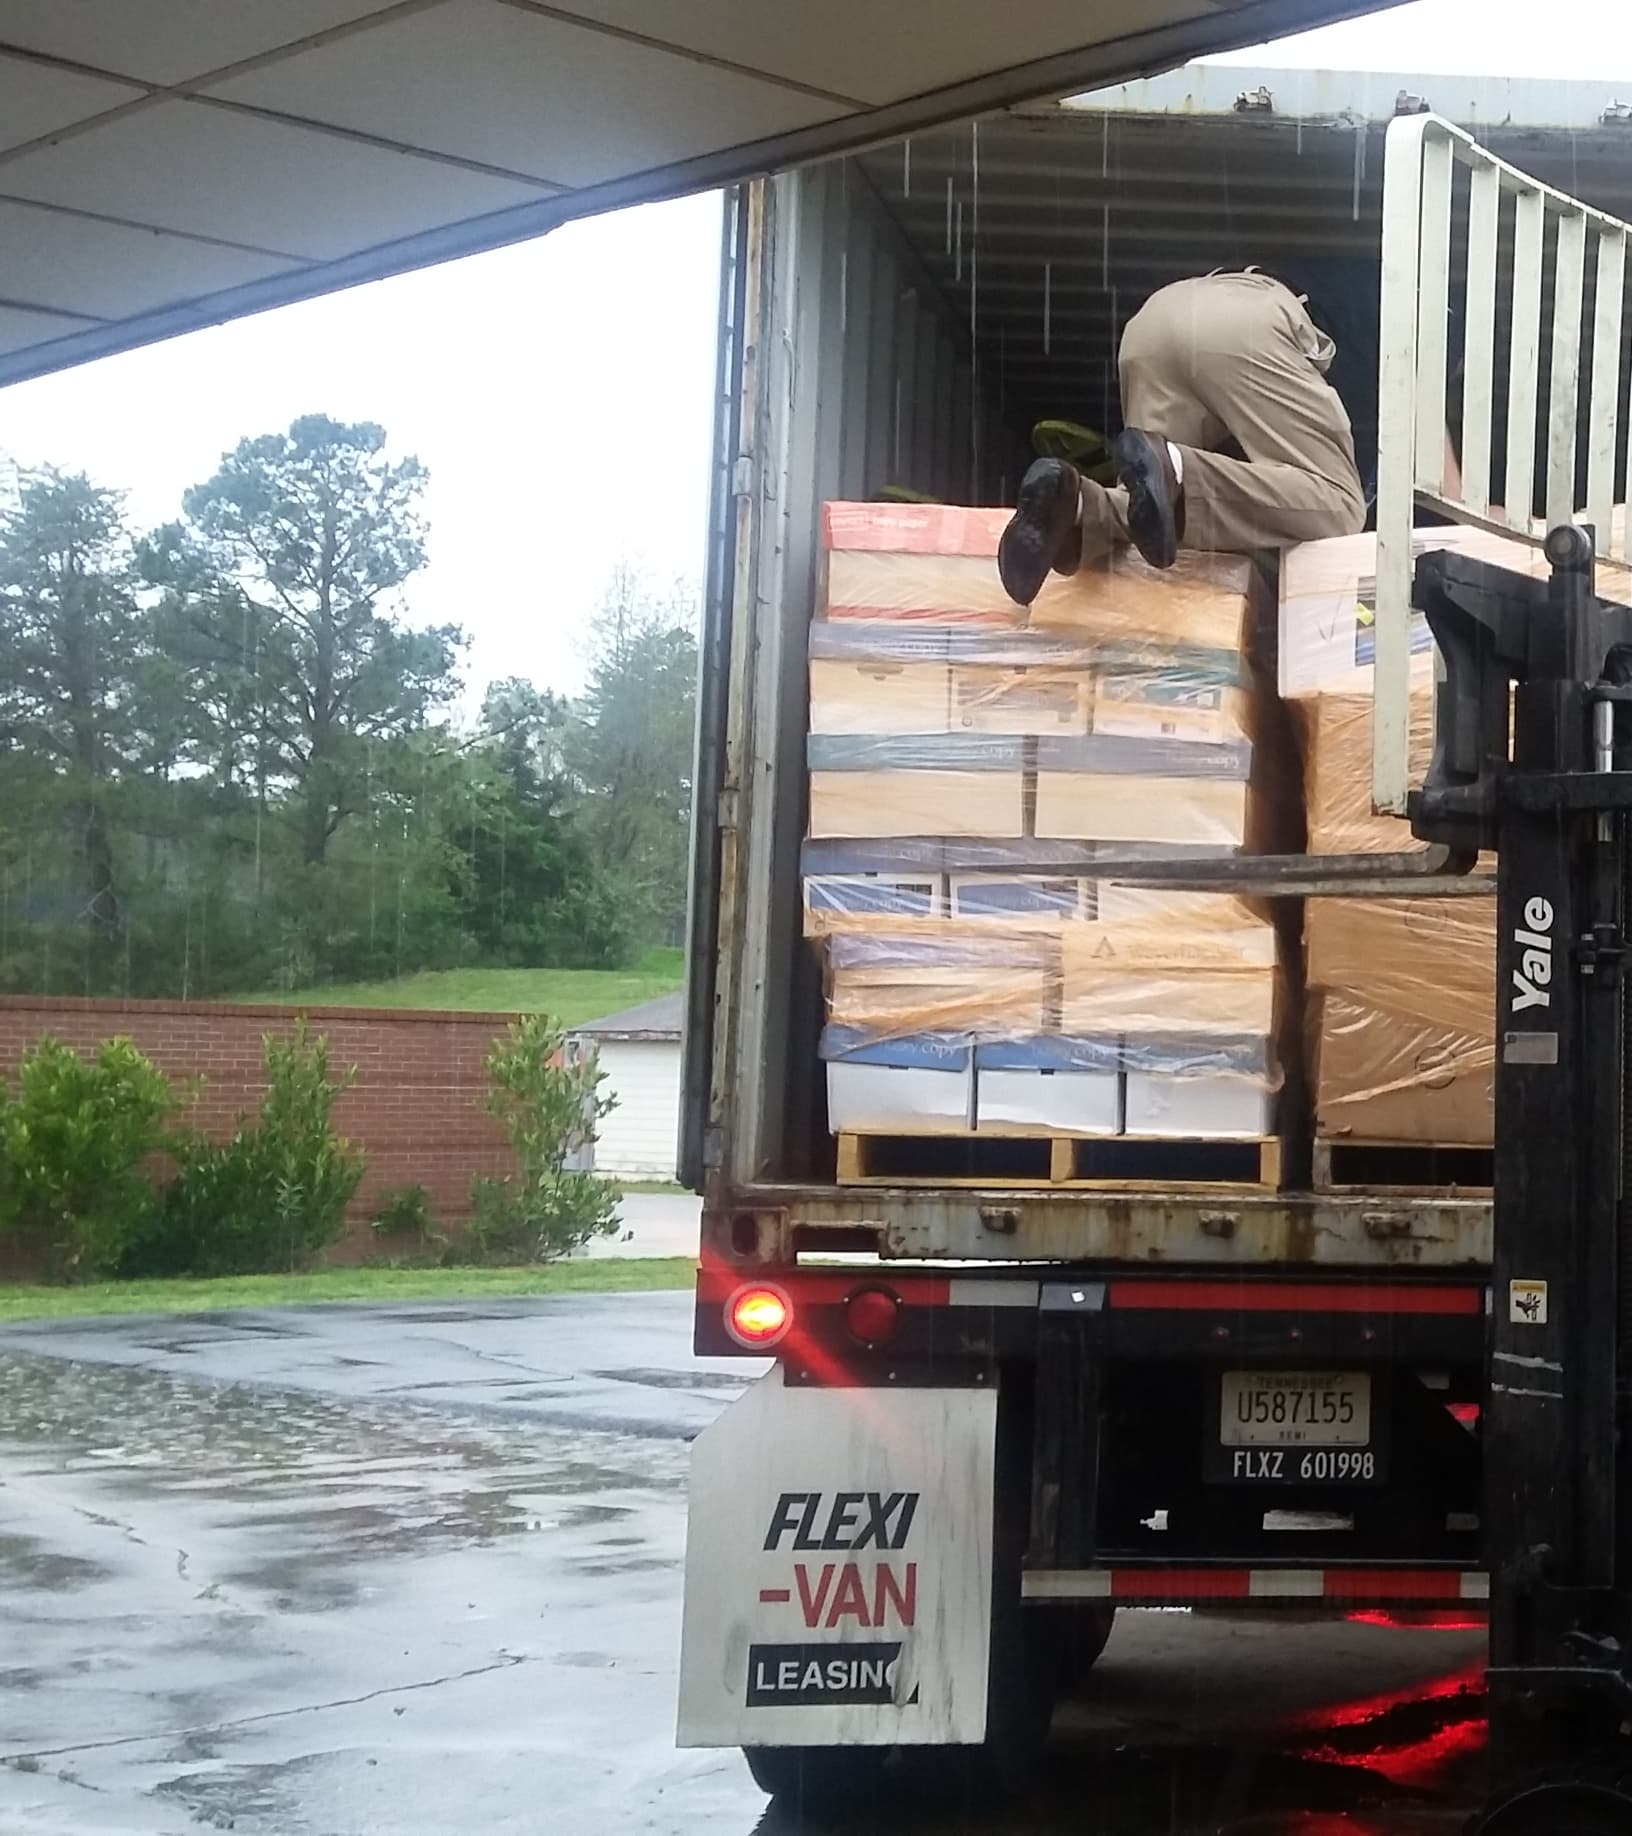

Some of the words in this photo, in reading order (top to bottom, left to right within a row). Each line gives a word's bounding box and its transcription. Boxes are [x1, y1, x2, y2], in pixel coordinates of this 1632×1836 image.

[1511, 896, 1554, 1012] Yale
[1238, 1391, 1354, 1424] U587155
[1233, 1451, 1284, 1478] FLXZ
[1300, 1452, 1375, 1479] 601998
[763, 1492, 920, 1551] FLEXI
[759, 1563, 917, 1628] -VAN
